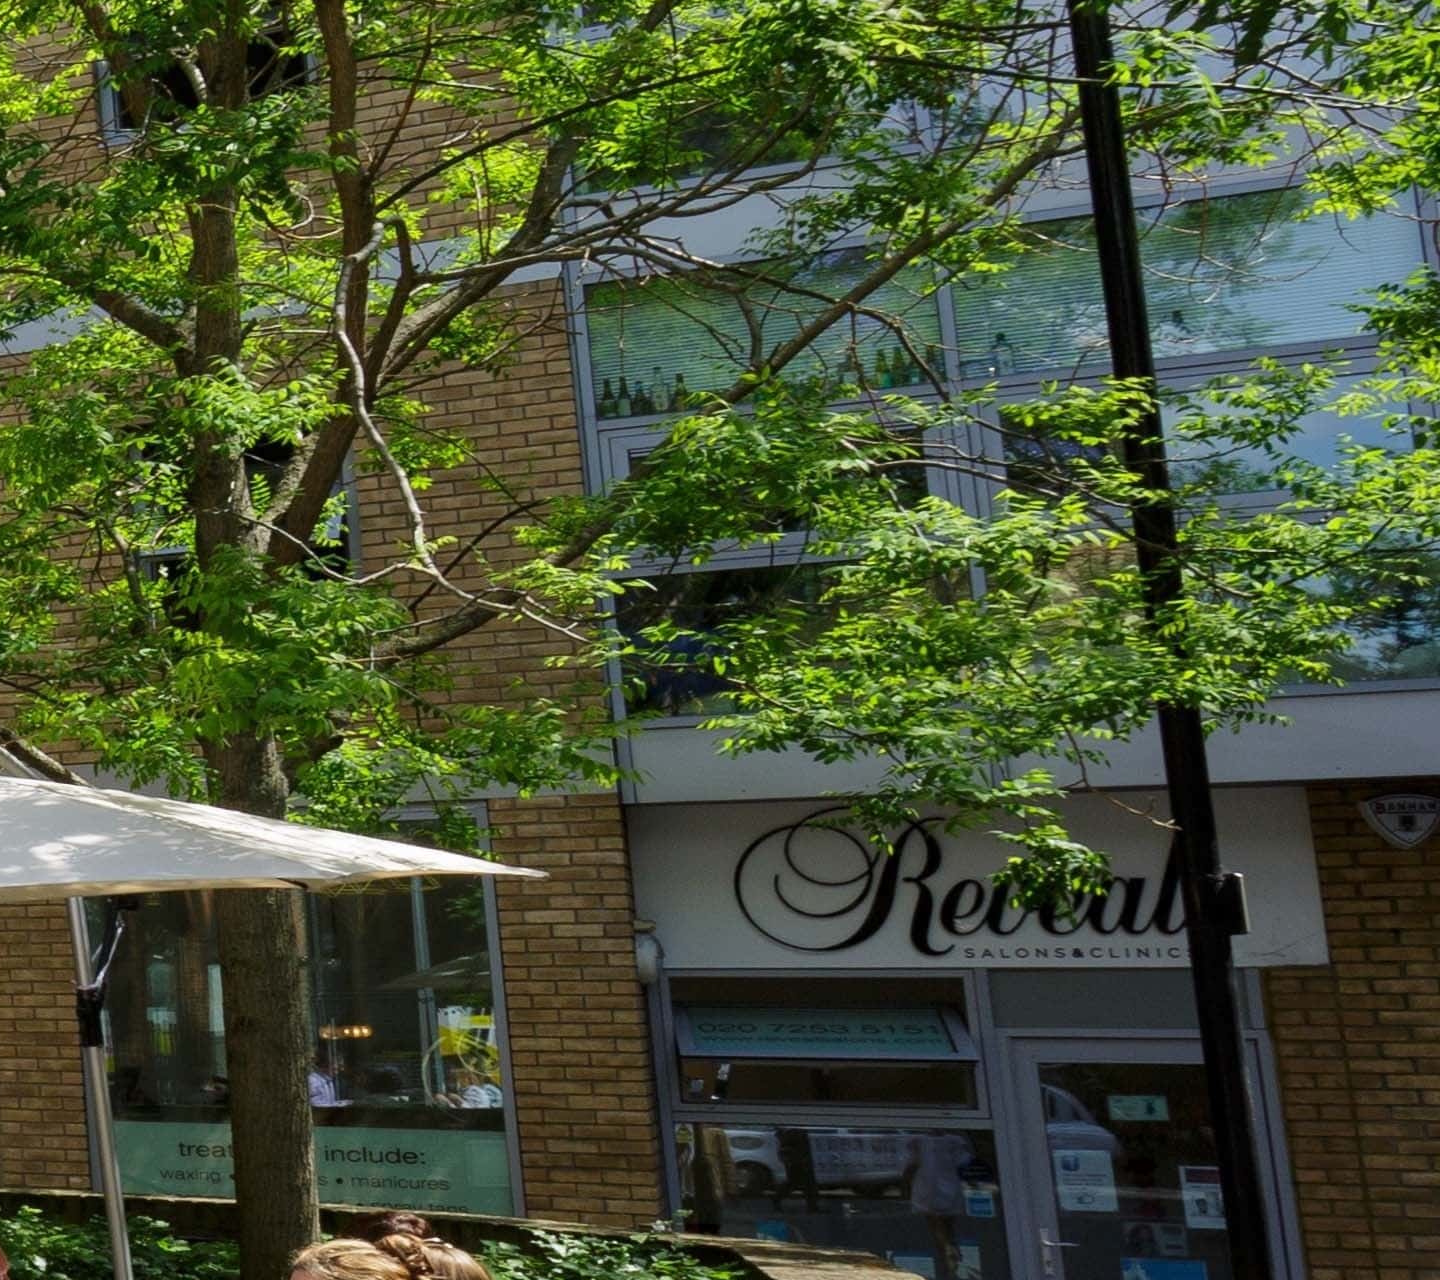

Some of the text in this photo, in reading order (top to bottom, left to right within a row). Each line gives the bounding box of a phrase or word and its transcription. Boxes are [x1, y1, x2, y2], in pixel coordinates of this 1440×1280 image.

[324, 1143, 427, 1166] include:
[160, 1167, 221, 1185] waxing
[351, 1173, 450, 1191] manicures
